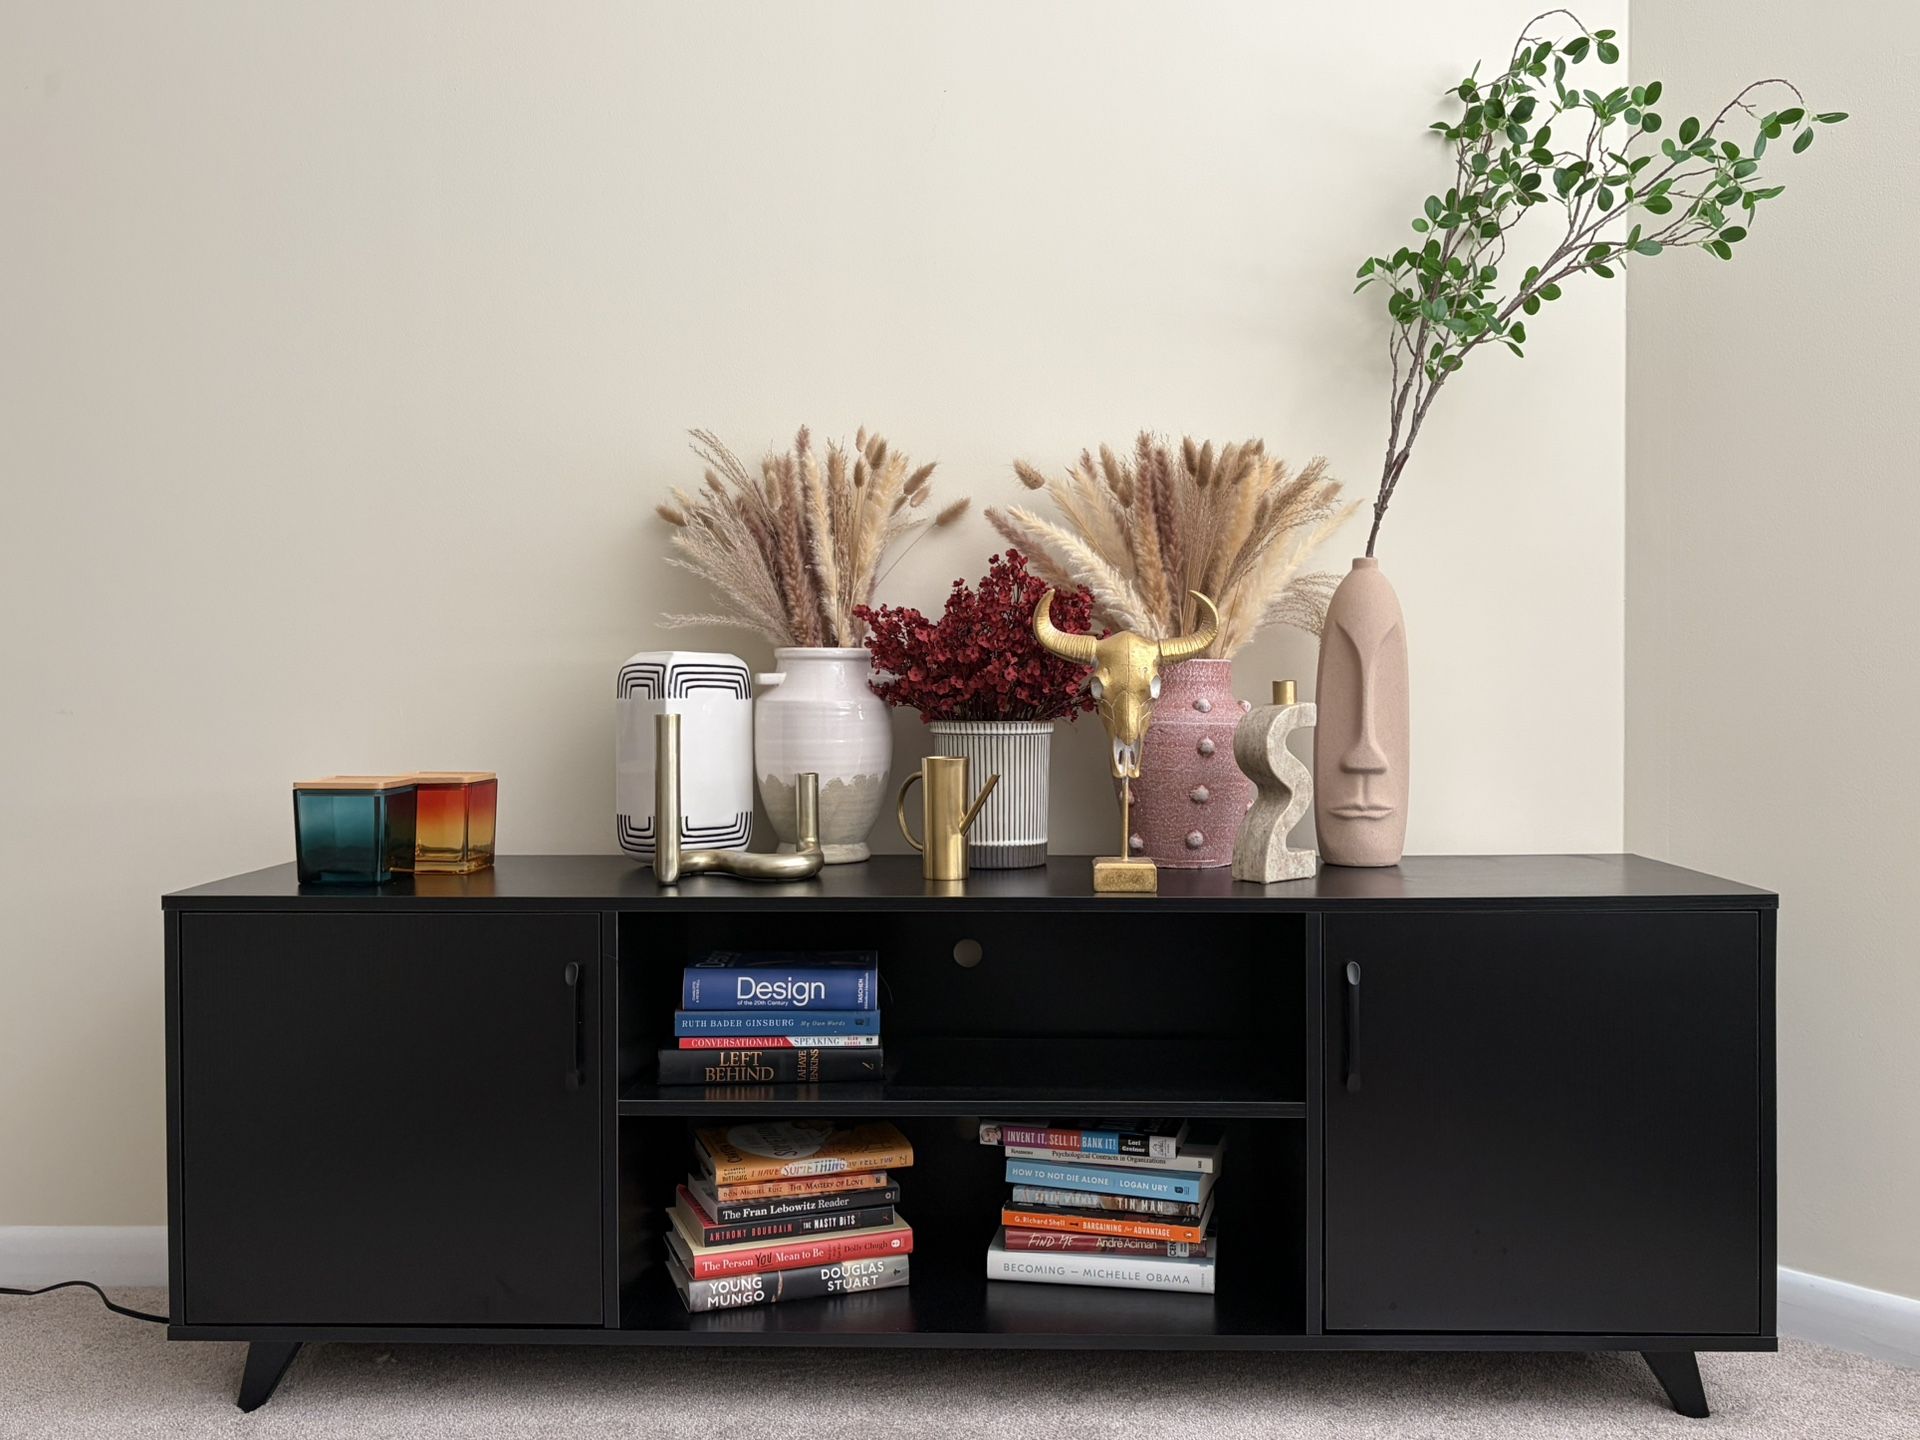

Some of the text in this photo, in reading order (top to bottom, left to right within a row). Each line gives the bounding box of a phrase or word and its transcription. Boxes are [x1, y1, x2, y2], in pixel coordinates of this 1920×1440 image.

[737, 977, 825, 1006] Design
[682, 1018, 795, 1028] RUTH BADER GINSBURG
[691, 1037, 840, 1048] CONVERSATIONALLY SPEAKING
[719, 1051, 762, 1066] LEFT
[705, 1067, 775, 1082] BEHIND
[1007, 1131, 1116, 1150] INVENT IT. SELL IT. BANK IT!
[1052, 1151, 1091, 1161] Psychological
[1092, 1153, 1119, 1162] Contracts
[1127, 1156, 1166, 1165] Organizations
[758, 1168, 780, 1177] HAVE
[782, 1159, 846, 1177] SOMETHING
[1012, 1168, 1109, 1185] HOW TO NOT DIE ALONE
[789, 1178, 864, 1192] THE MASTERY OF LOVE
[1119, 1179, 1169, 1193] LOGAN URY
[722, 1198, 850, 1221] The Fran Lebowitz Reader
[1117, 1197, 1164, 1212] TIN MAN
[814, 1217, 837, 1229] NASTY
[1022, 1216, 1047, 1226] Richard
[1049, 1218, 1066, 1227] Shell
[1082, 1221, 1122, 1233] BARGAINING
[1133, 1226, 1170, 1237] ADVANTAGE
[709, 1230, 747, 1242] ANTHONY
[1096, 1236, 1158, 1250] André Aciman
[703, 1260, 721, 1272] The
[723, 1258, 754, 1270] Person
[775, 1252, 801, 1263] Mean
[802, 1250, 811, 1260] to
[812, 1249, 824, 1258] Be
[821, 1261, 885, 1281] DOUGLAS
[1003, 1262, 1066, 1276] BECOMING
[1082, 1268, 1141, 1282] MICHELLE
[1146, 1273, 1191, 1285] OBAMA
[709, 1276, 763, 1295] YOUNG
[827, 1275, 879, 1291] STUART
[707, 1290, 765, 1308] MUNGO
